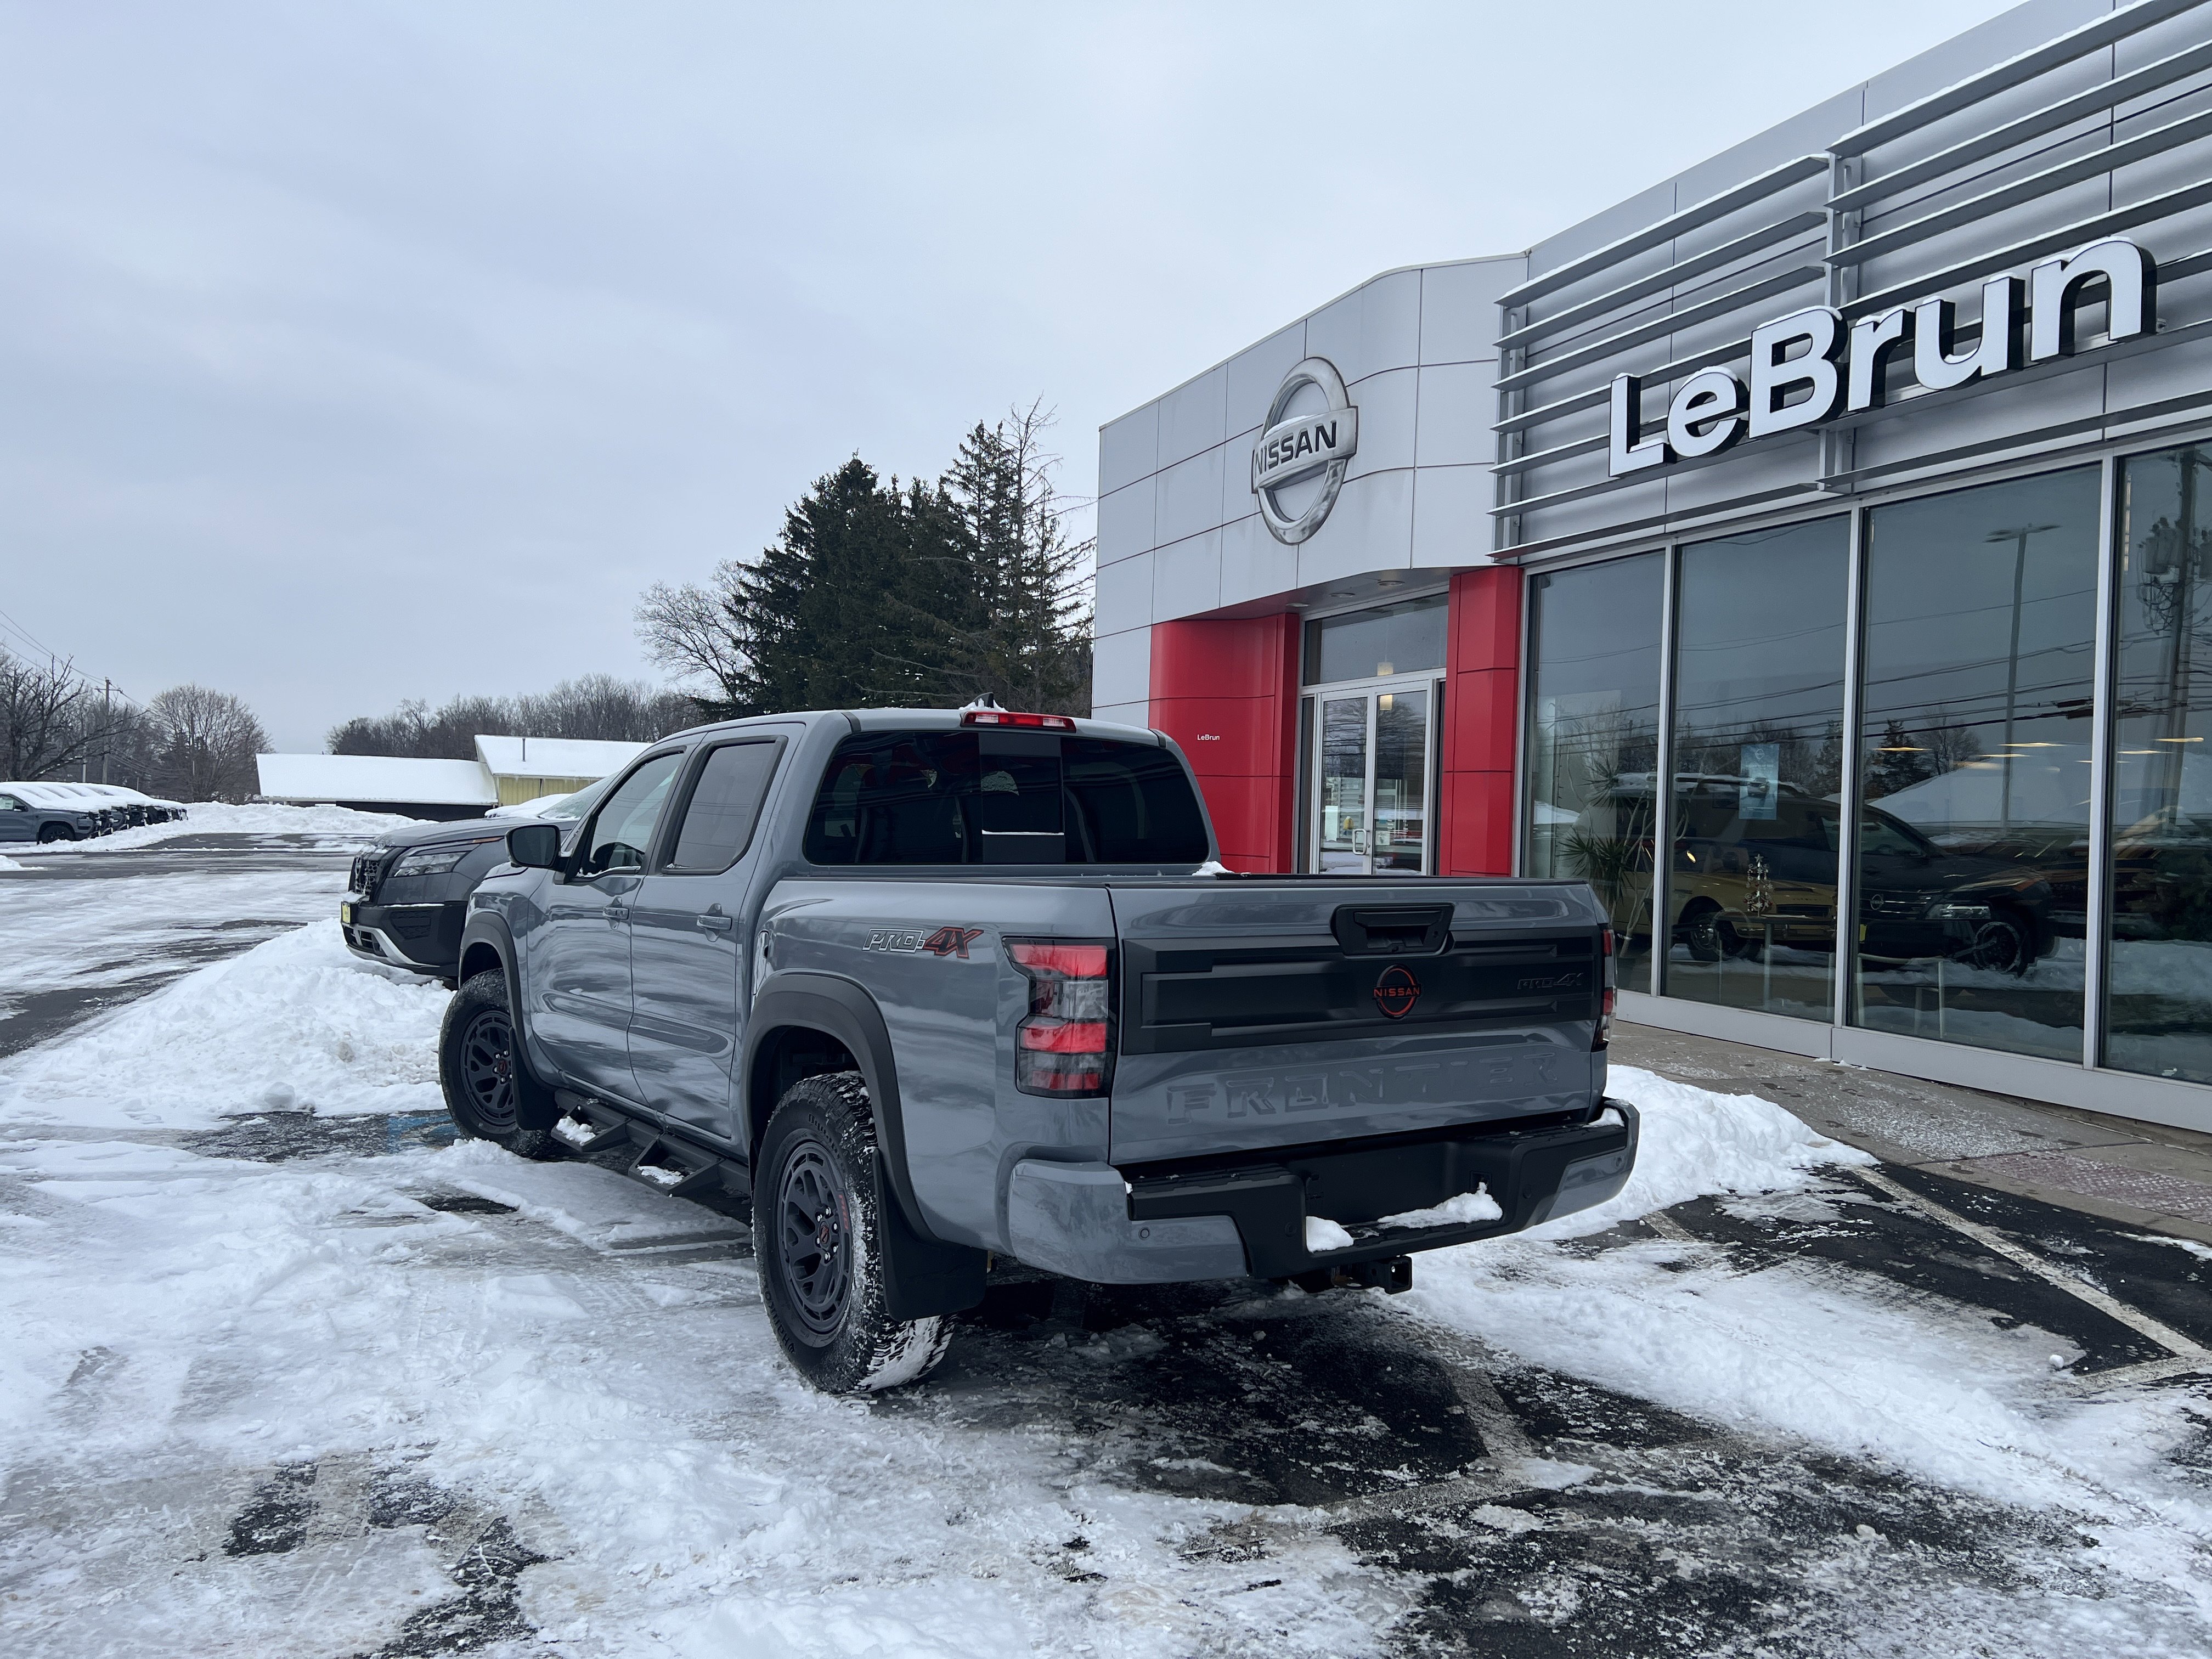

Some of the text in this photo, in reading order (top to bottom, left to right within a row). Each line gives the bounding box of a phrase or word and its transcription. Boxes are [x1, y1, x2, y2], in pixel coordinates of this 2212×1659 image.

[1609, 235, 2158, 478] LeBrun
[1255, 420, 1338, 479] NISSAN
[1373, 987, 1420, 997] NISSAN
[1166, 1052, 1559, 1125] FRONTIER
